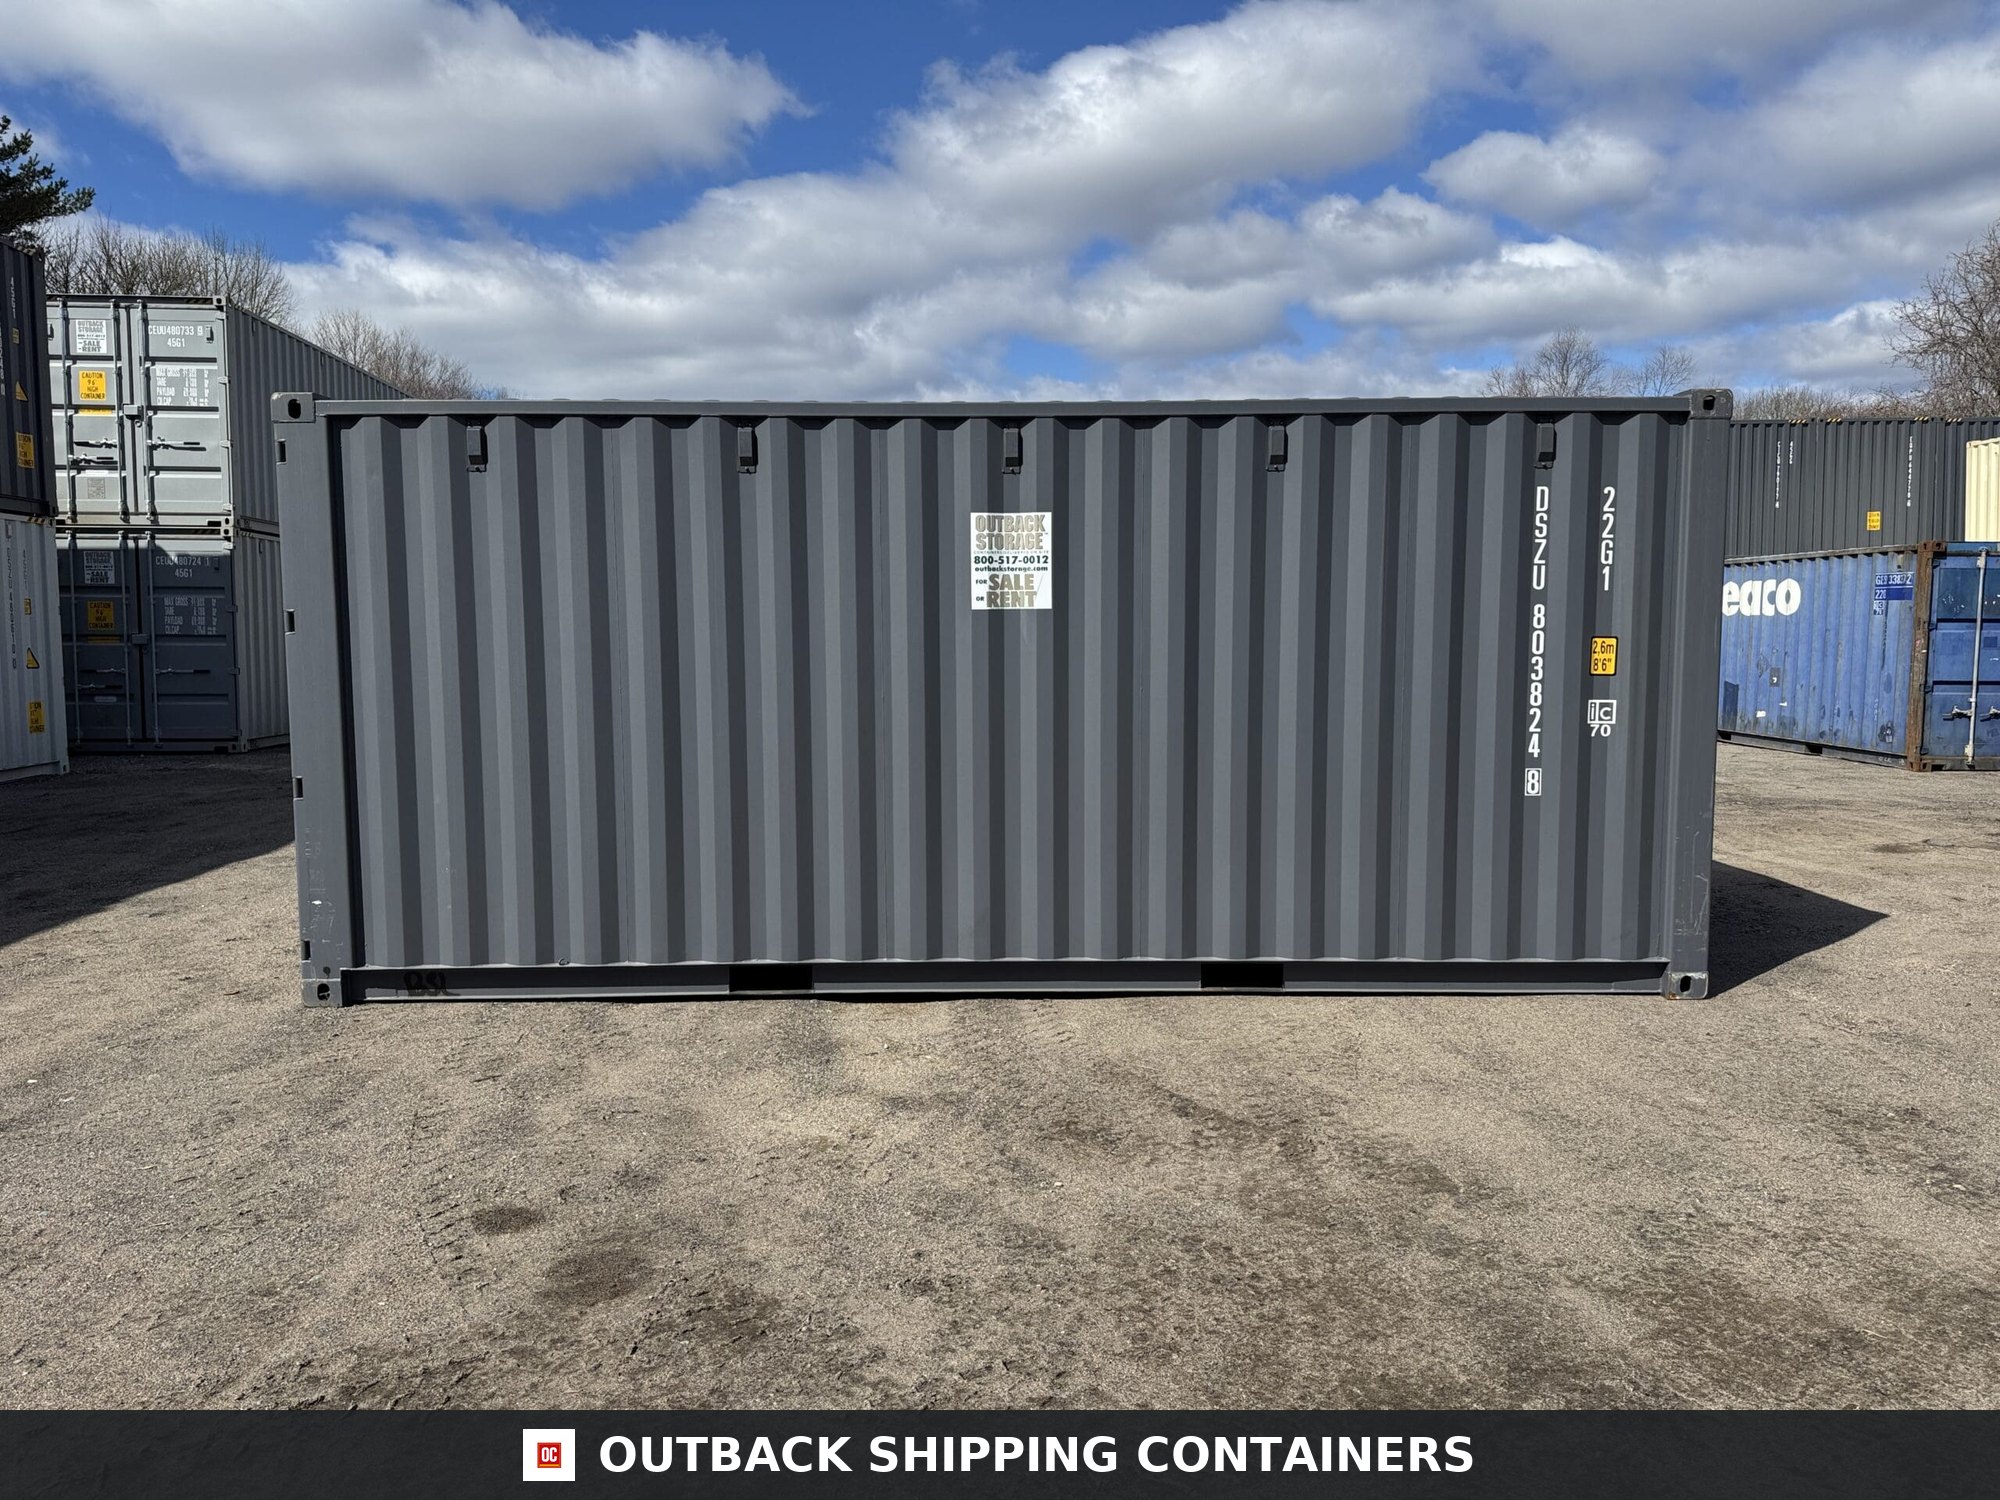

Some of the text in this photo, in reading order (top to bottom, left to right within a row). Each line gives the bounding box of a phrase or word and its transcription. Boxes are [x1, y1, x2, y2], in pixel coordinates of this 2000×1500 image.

[167, 337, 185, 347] 45G1
[975, 514, 1046, 532] OUTBACK
[975, 533, 1044, 550] STORAGE
[1601, 486, 1616, 591] 22G1
[974, 555, 1049, 565] 800-517-0012
[175, 568, 193, 577] 45G1
[988, 573, 1034, 590] SALE
[986, 591, 1037, 607] RENT
[1526, 486, 1549, 795] DSZU 803824 8
[1593, 658, 1612, 672] 8'6"
[1590, 724, 1611, 737] 70
